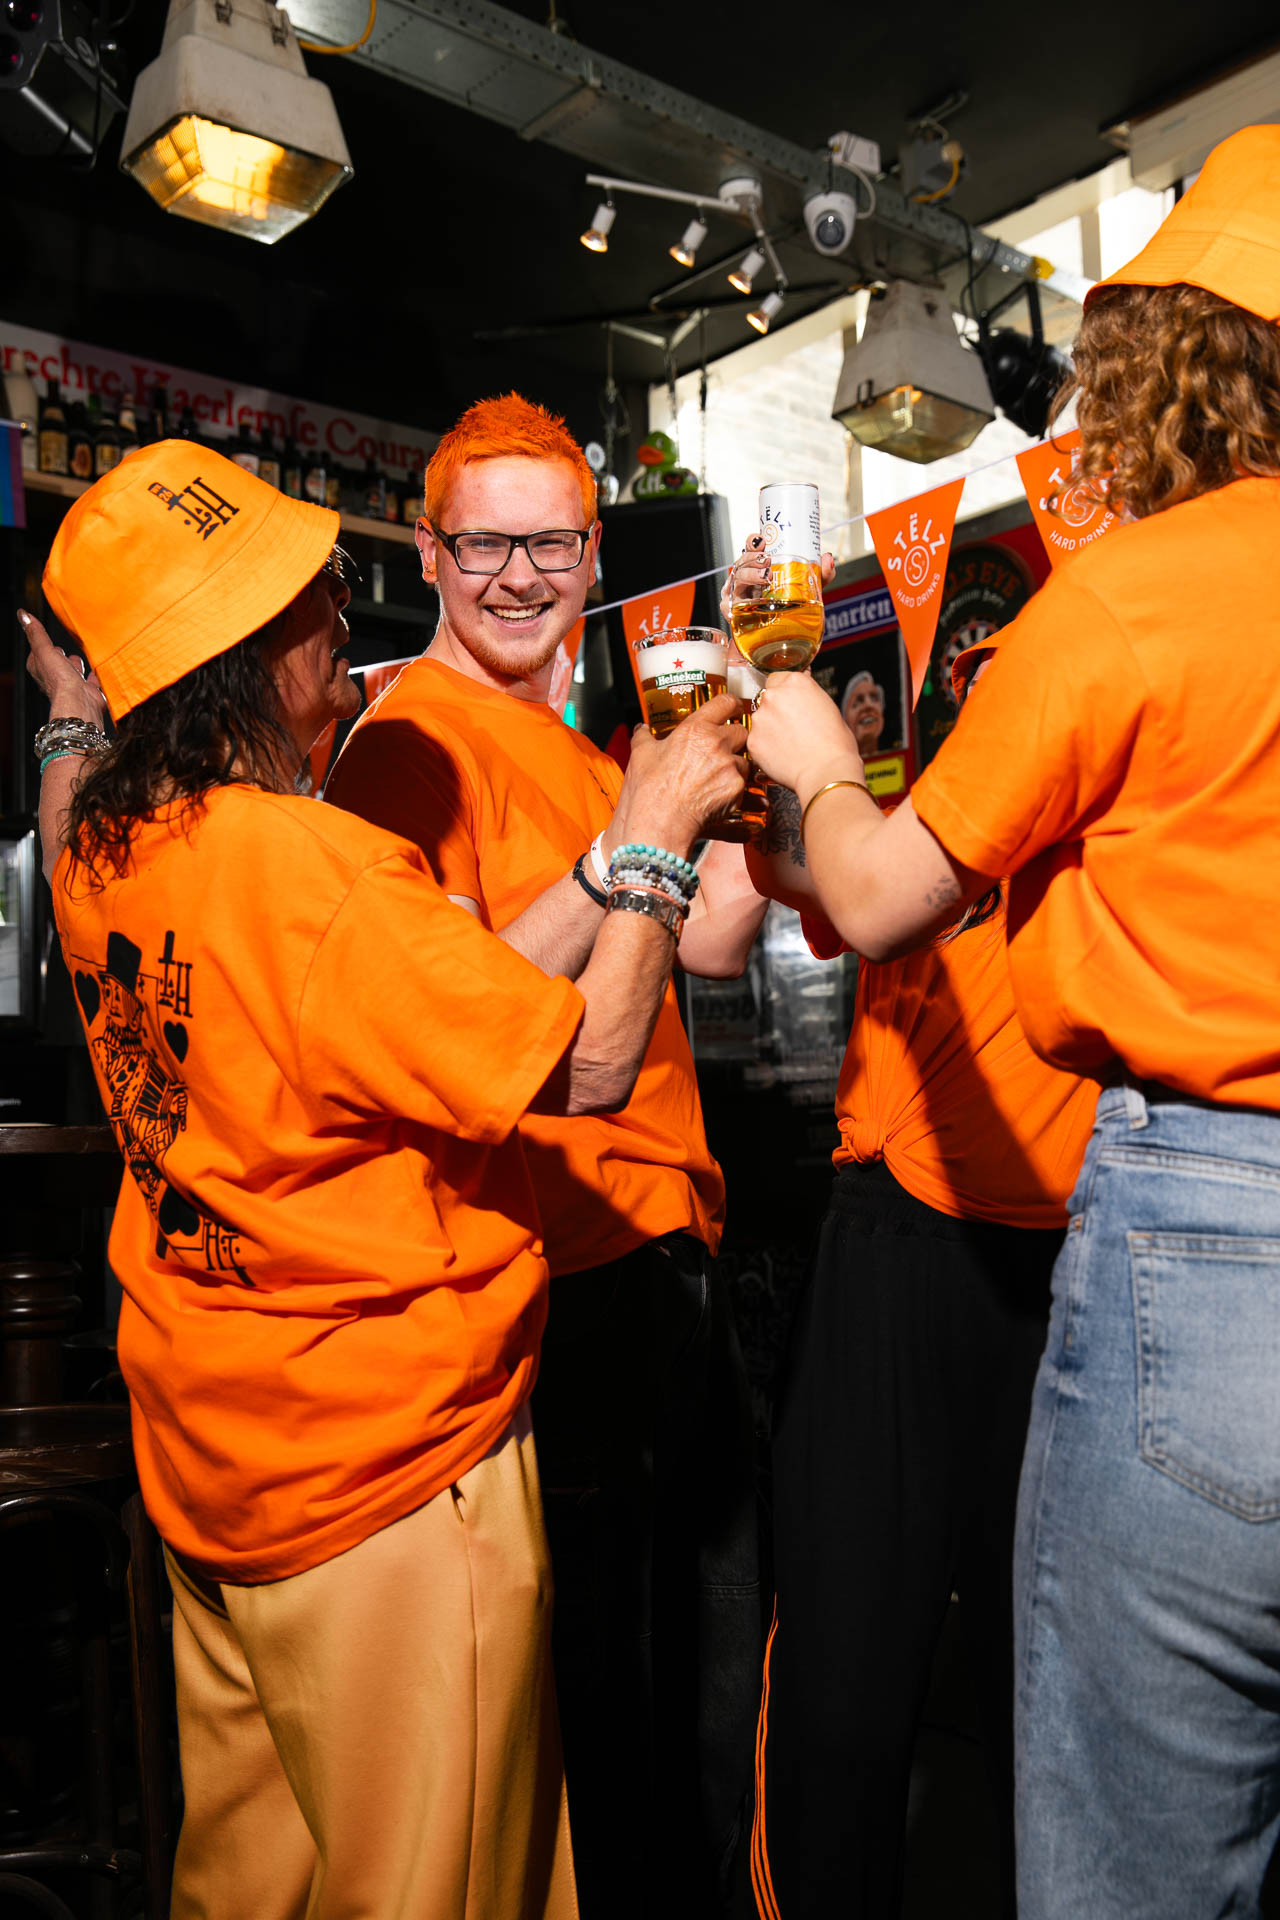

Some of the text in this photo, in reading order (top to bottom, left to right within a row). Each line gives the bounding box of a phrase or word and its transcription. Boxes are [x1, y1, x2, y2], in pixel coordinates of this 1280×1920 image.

[0, 342, 121, 397] rechte
[325, 417, 433, 473] Coura
[887, 512, 946, 572] STËLZ
[1049, 530, 1076, 551] HARD
[896, 572, 941, 608] HARD DRINKS
[825, 598, 892, 634] garten
[657, 671, 704, 687] Heineken
